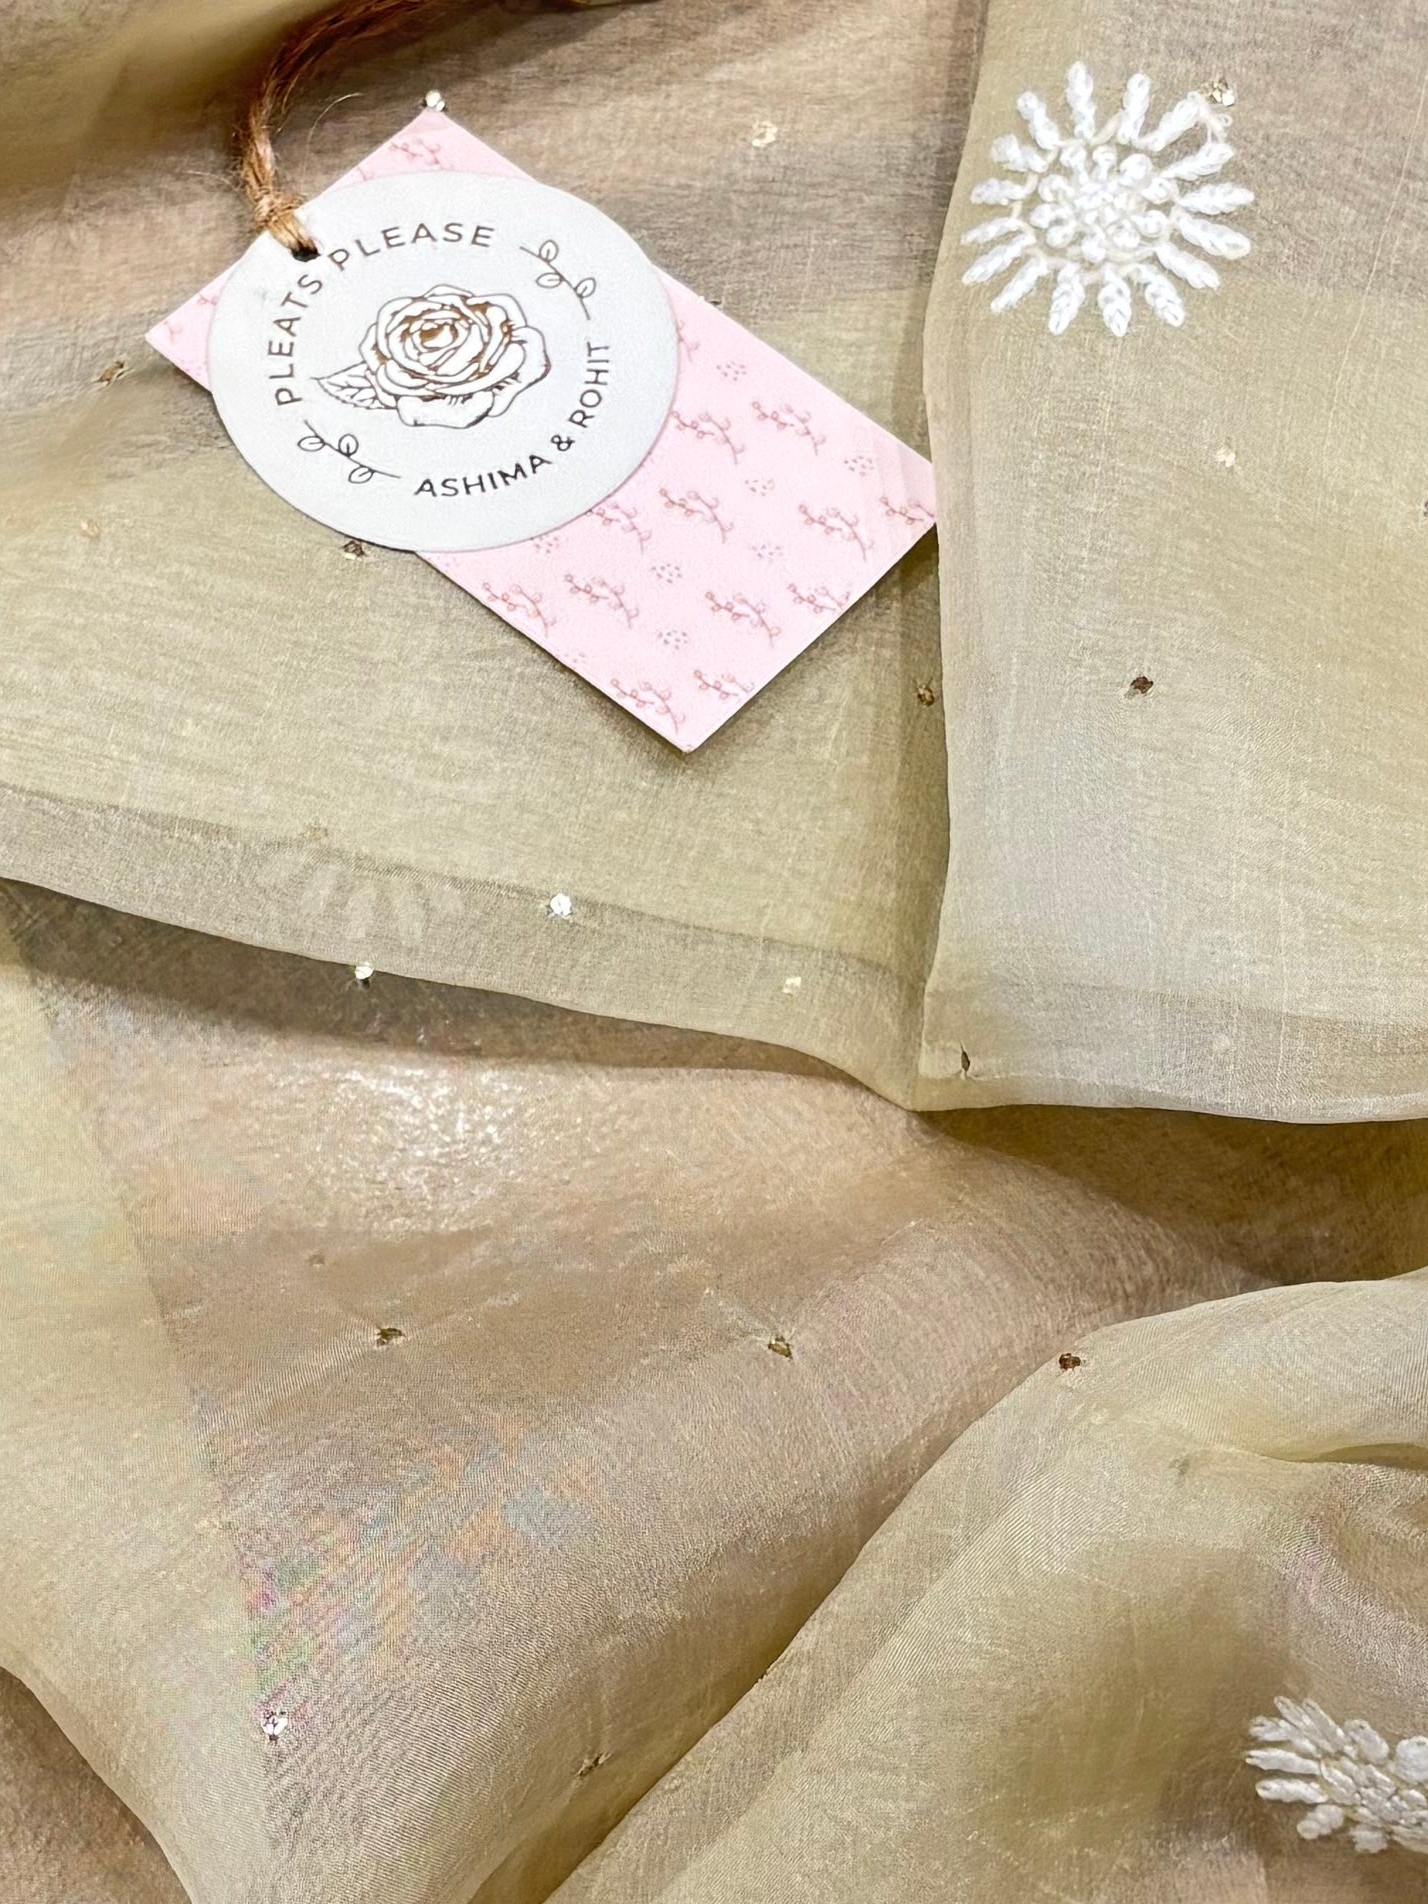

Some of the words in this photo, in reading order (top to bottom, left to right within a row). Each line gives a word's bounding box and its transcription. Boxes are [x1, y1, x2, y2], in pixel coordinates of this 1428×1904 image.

[267, 273, 324, 406] PLEATS
[328, 222, 495, 272] PLEASE
[413, 453, 552, 498] ASHIMA
[551, 433, 575, 453] &
[568, 341, 610, 429] ROHIT
